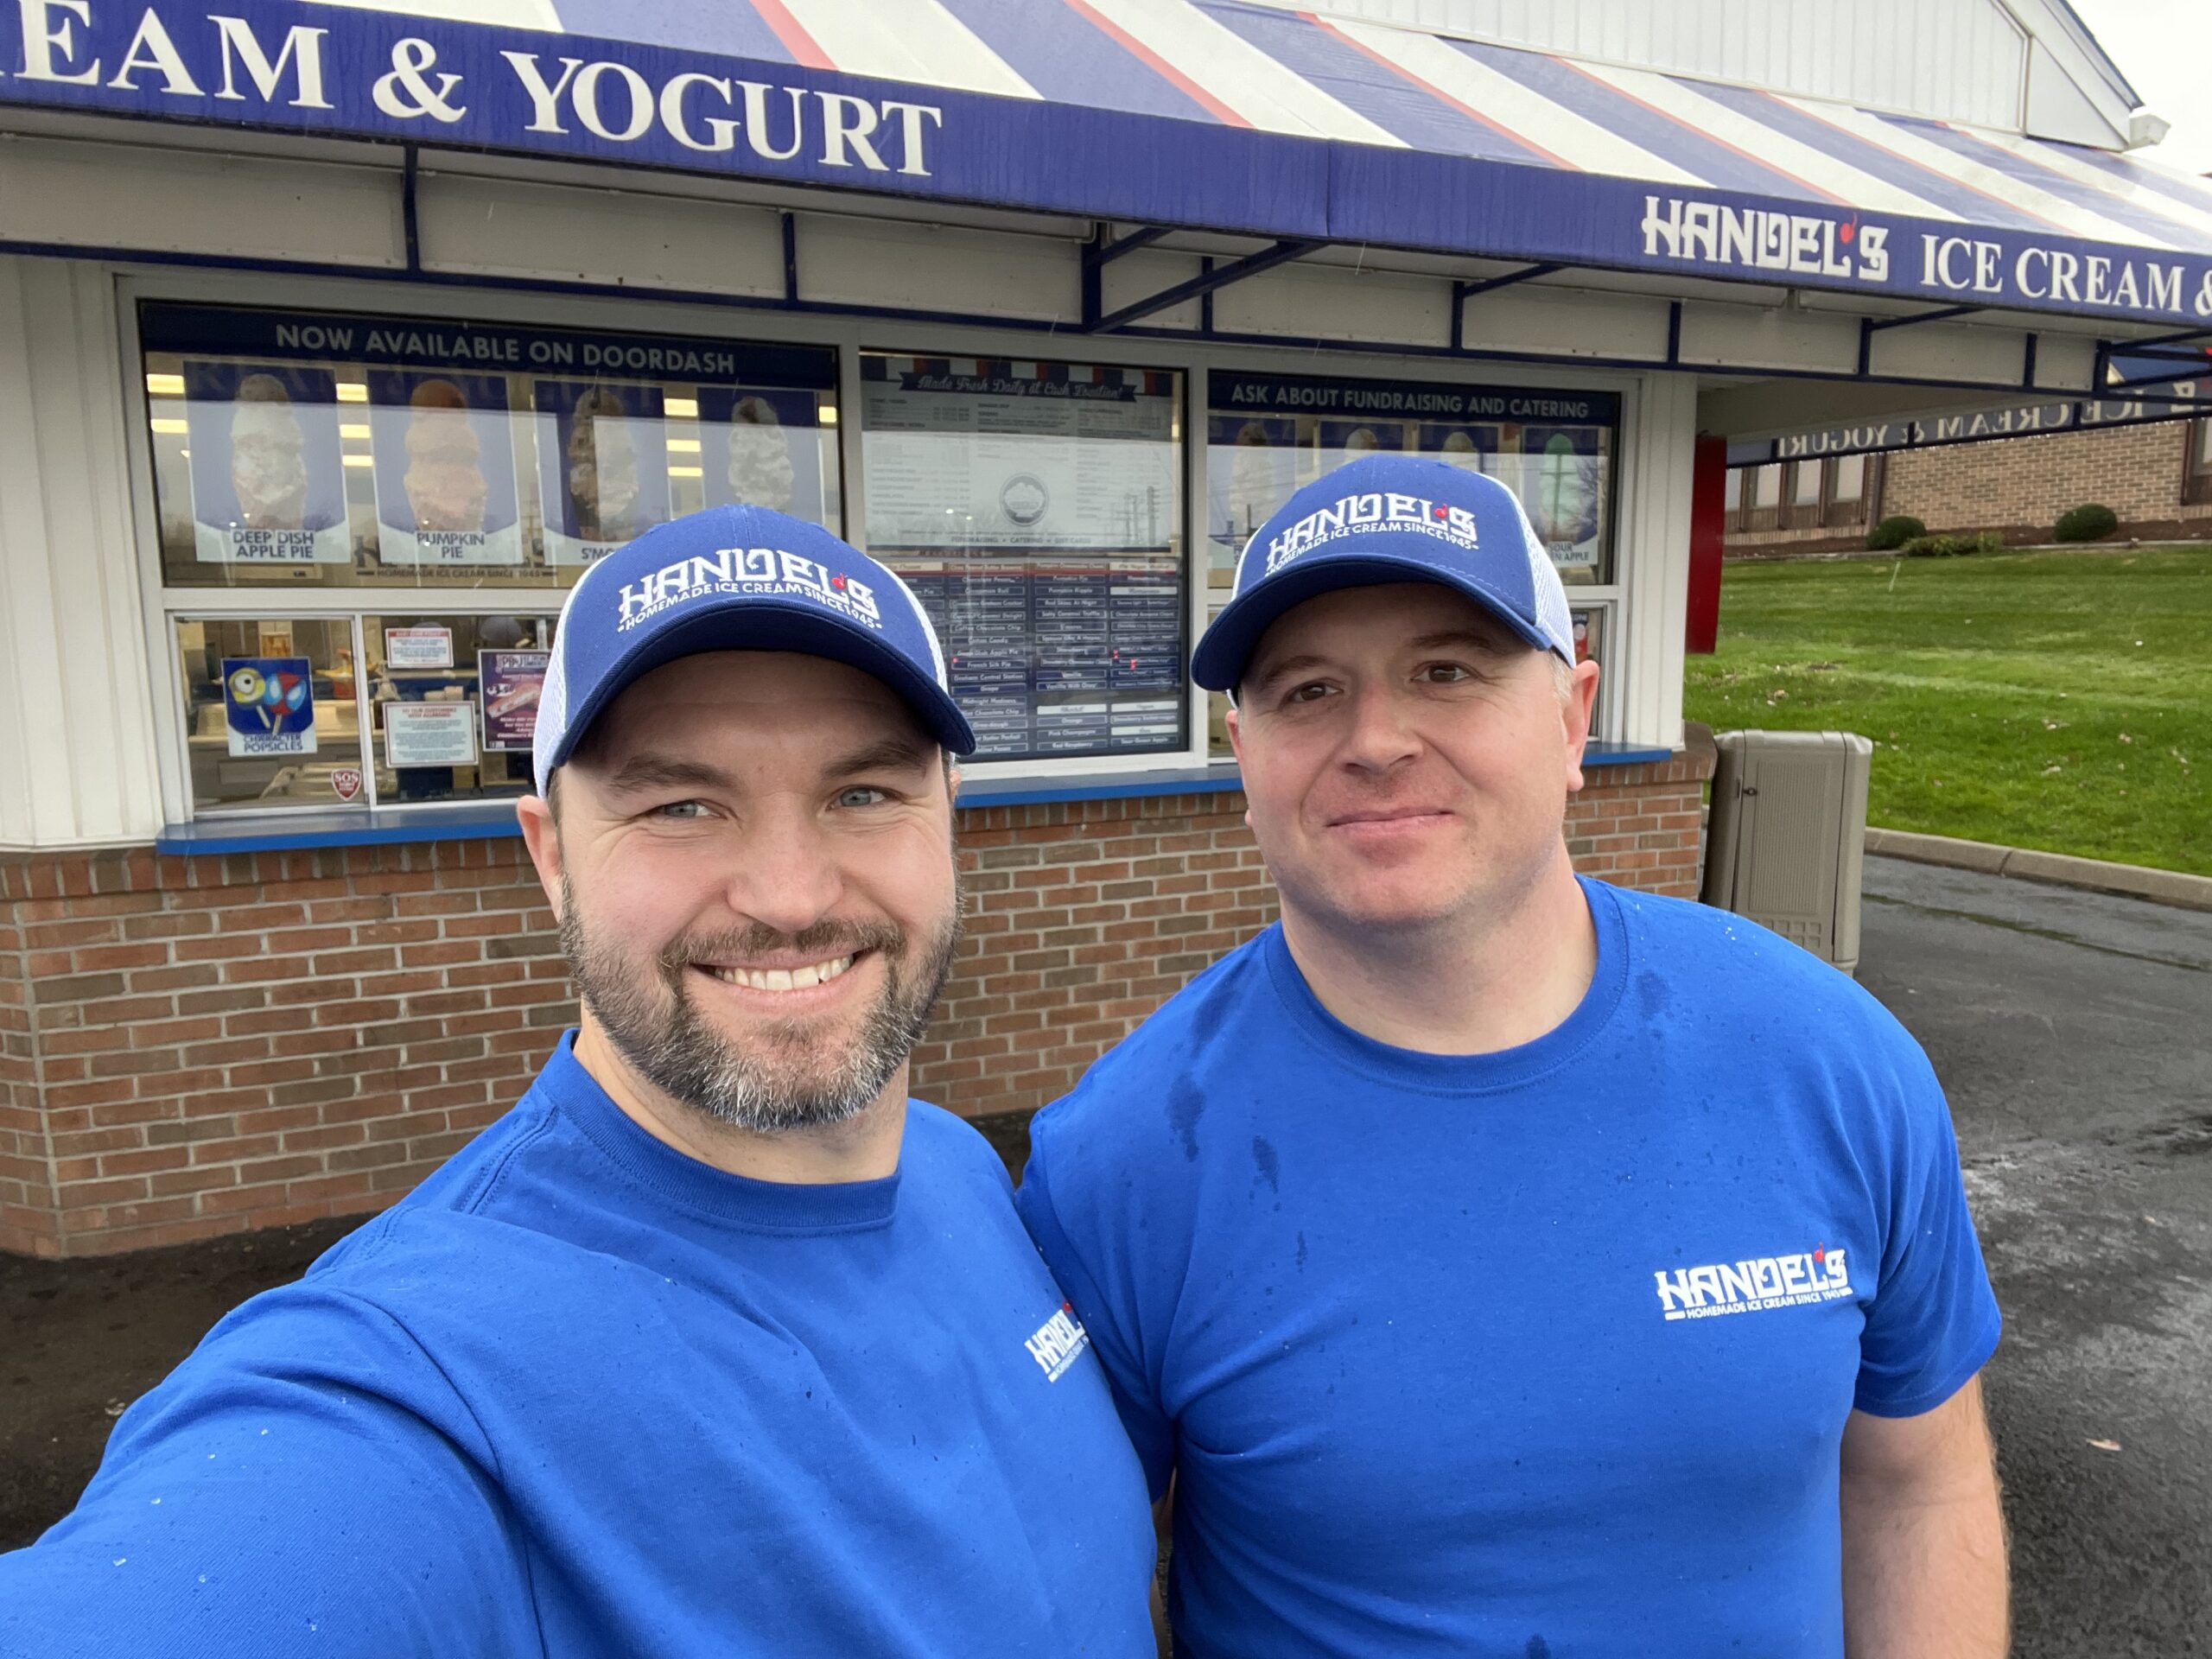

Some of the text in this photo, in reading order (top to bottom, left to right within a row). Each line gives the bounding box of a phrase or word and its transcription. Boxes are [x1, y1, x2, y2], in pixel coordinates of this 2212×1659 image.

[0, 0, 942, 176] EAM & YOGURT
[1641, 195, 1890, 283] HANDEL'S
[1920, 234, 2003, 293] ICE
[2015, 247, 2185, 313] CREAM
[276, 323, 734, 375] NOW AVAILABLE ON DOORDASH
[918, 375, 952, 388] Made
[956, 378, 988, 391] Fresh
[992, 379, 1026, 395] Daily
[1231, 385, 1589, 418] ASK ABOUT FUNDRAISING AND CATERING
[232, 531, 315, 545] DEEP DISH
[416, 532, 485, 545] PUMPKIN
[1266, 493, 1478, 571] HANDEL'S
[1331, 527, 1351, 540] ICE
[1351, 522, 1402, 534] CREAM
[1404, 523, 1444, 540] SINCE
[1443, 531, 1471, 550] 1945
[236, 544, 314, 558] APPLE PIE
[442, 546, 463, 558] PIE
[1548, 543, 1573, 552] SOUR
[1564, 552, 1589, 561] APPLE
[619, 548, 880, 624] HANDEL'S
[626, 582, 874, 631] HOMEMADE ICE CREAM SINCE 1945
[244, 733, 301, 743] CHARACTER
[244, 742, 303, 753] POPSICLES
[334, 772, 359, 782] SOS
[1654, 1245, 1848, 1311] HANDEL'S
[1687, 1303, 1746, 1319] HOMEMADE
[1747, 1300, 1763, 1312] ICE
[1764, 1295, 1796, 1310] CREAM
[1797, 1293, 1822, 1306] SINCE
